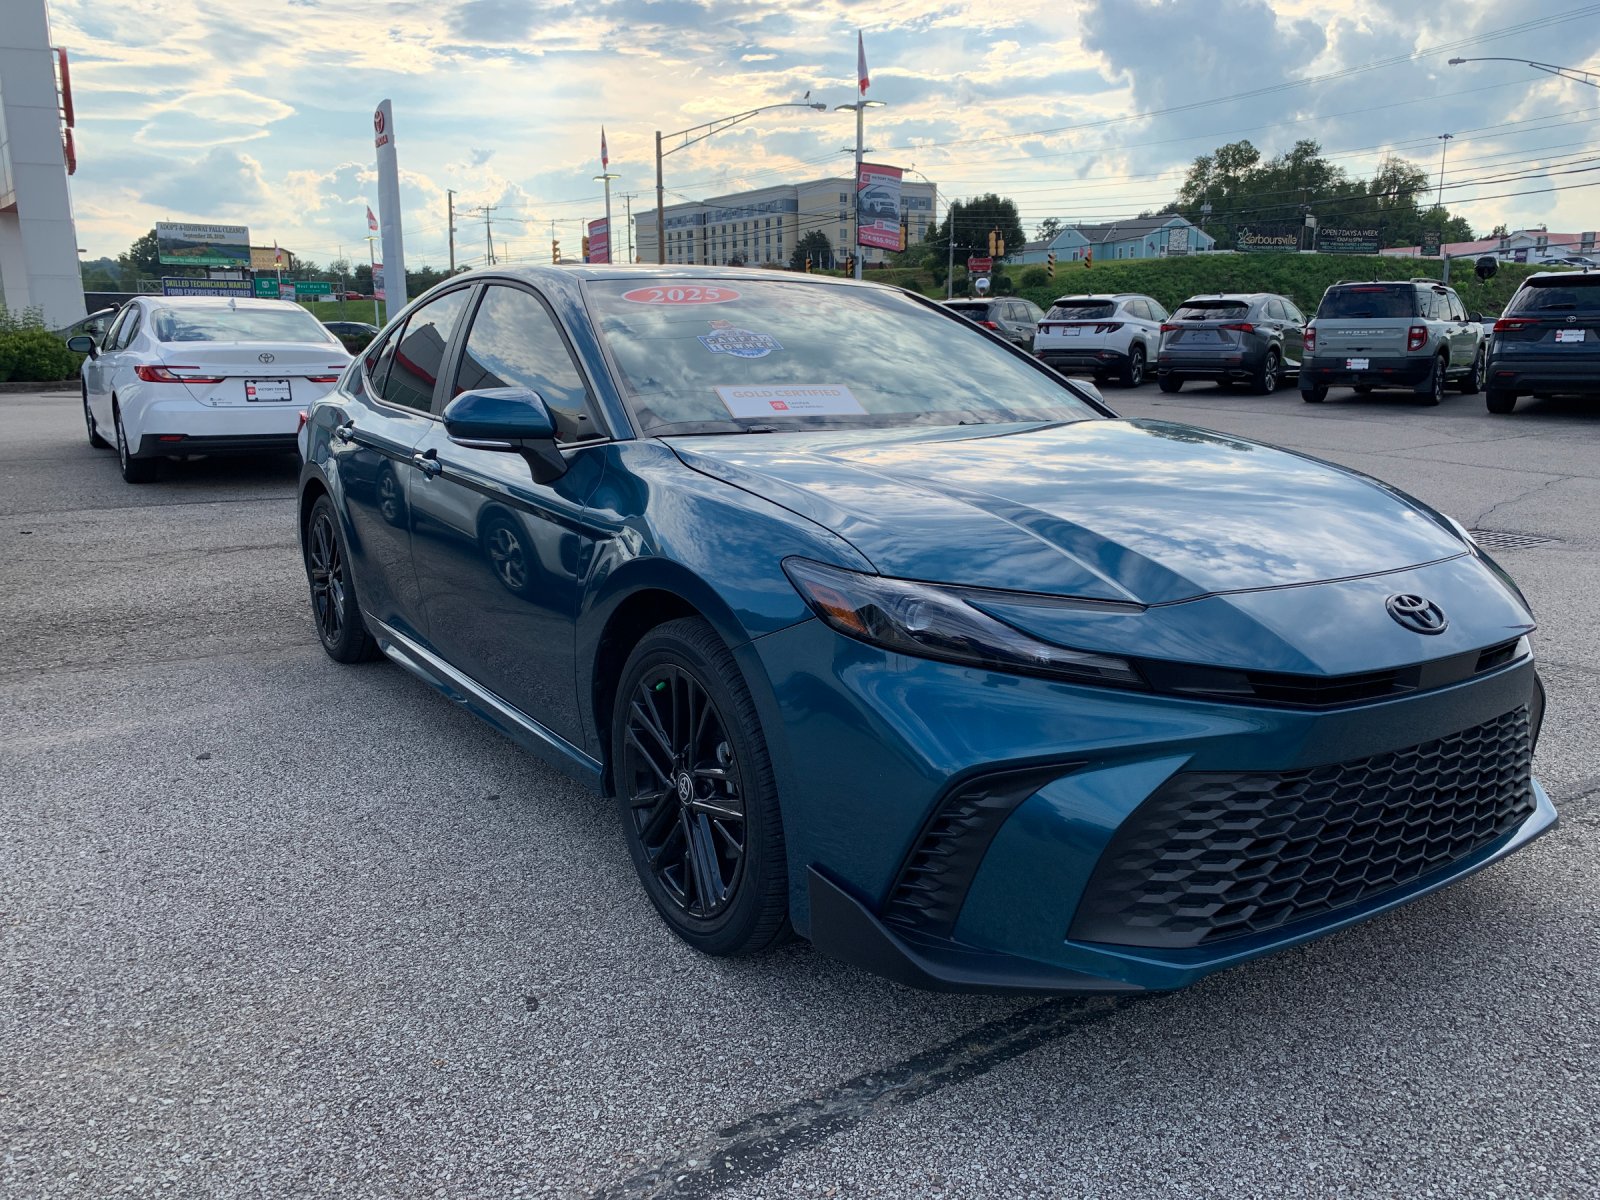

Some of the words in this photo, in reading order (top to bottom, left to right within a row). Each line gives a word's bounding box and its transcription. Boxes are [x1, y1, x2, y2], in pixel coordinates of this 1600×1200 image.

[1321, 228, 1338, 236] OPEN
[1342, 229, 1357, 237] DAYS
[1362, 229, 1379, 237] WEEK
[165, 279, 190, 288] SKILLED
[190, 280, 227, 288] TECHNICIANS
[228, 281, 251, 289] WANTED
[167, 288, 183, 296] FORD
[184, 288, 219, 296] EXPERIENCE
[219, 289, 251, 297] PREFERRED
[648, 288, 720, 303] 2025
[732, 390, 773, 398] GOLD
[774, 389, 841, 397] CERTIFIED
